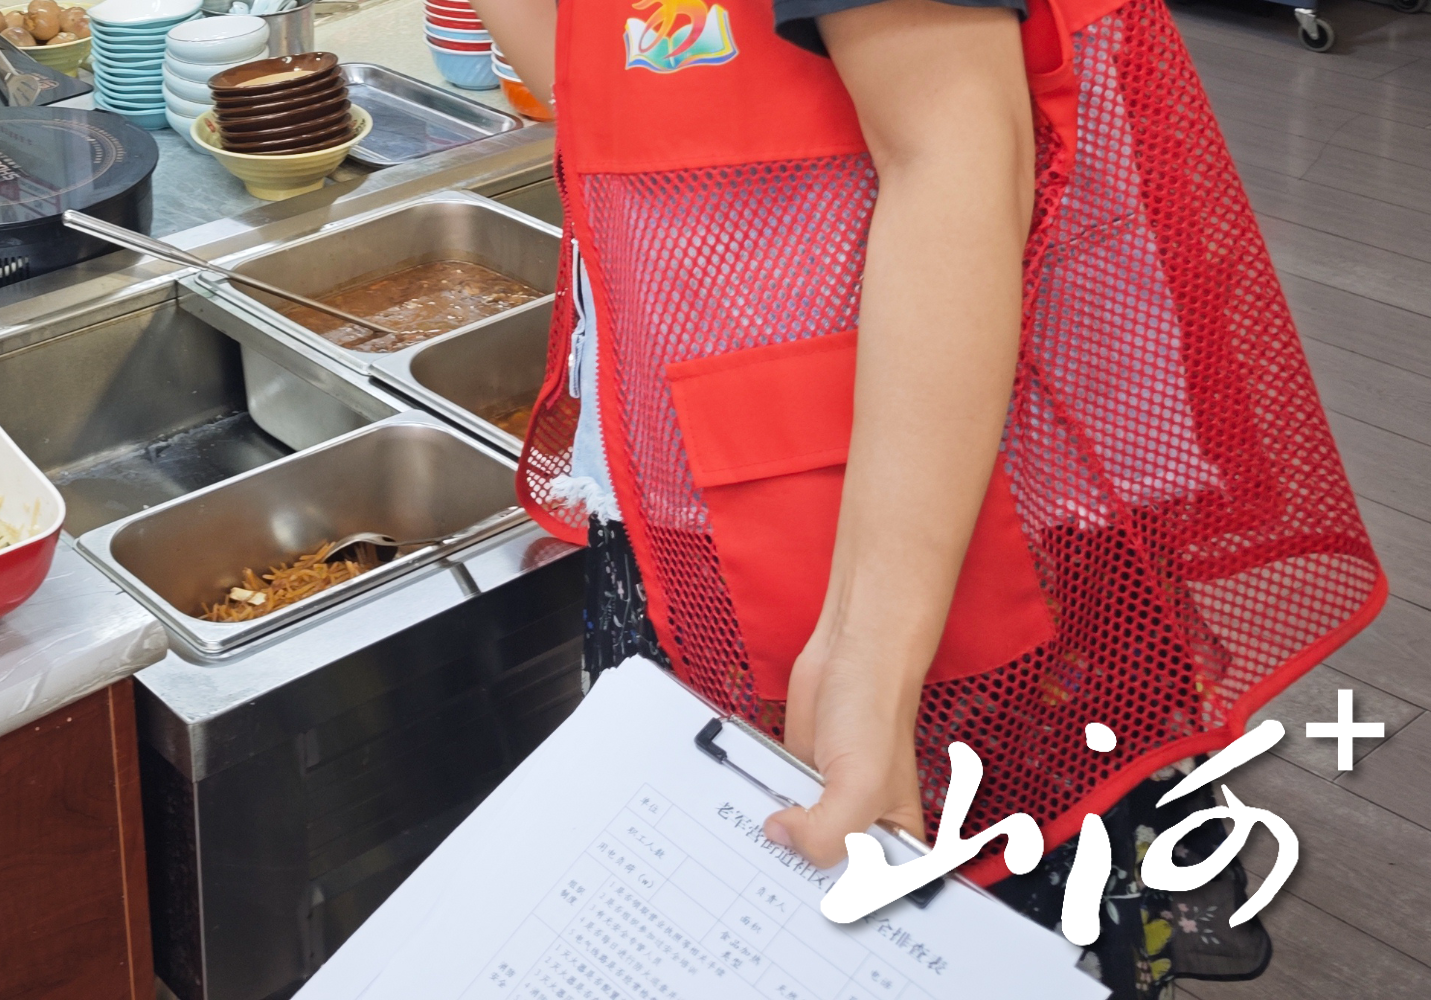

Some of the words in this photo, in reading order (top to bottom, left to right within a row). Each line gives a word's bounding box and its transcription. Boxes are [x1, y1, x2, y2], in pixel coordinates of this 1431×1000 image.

[626, 825, 665, 859] 职工人数
[755, 886, 787, 913] 负责人
